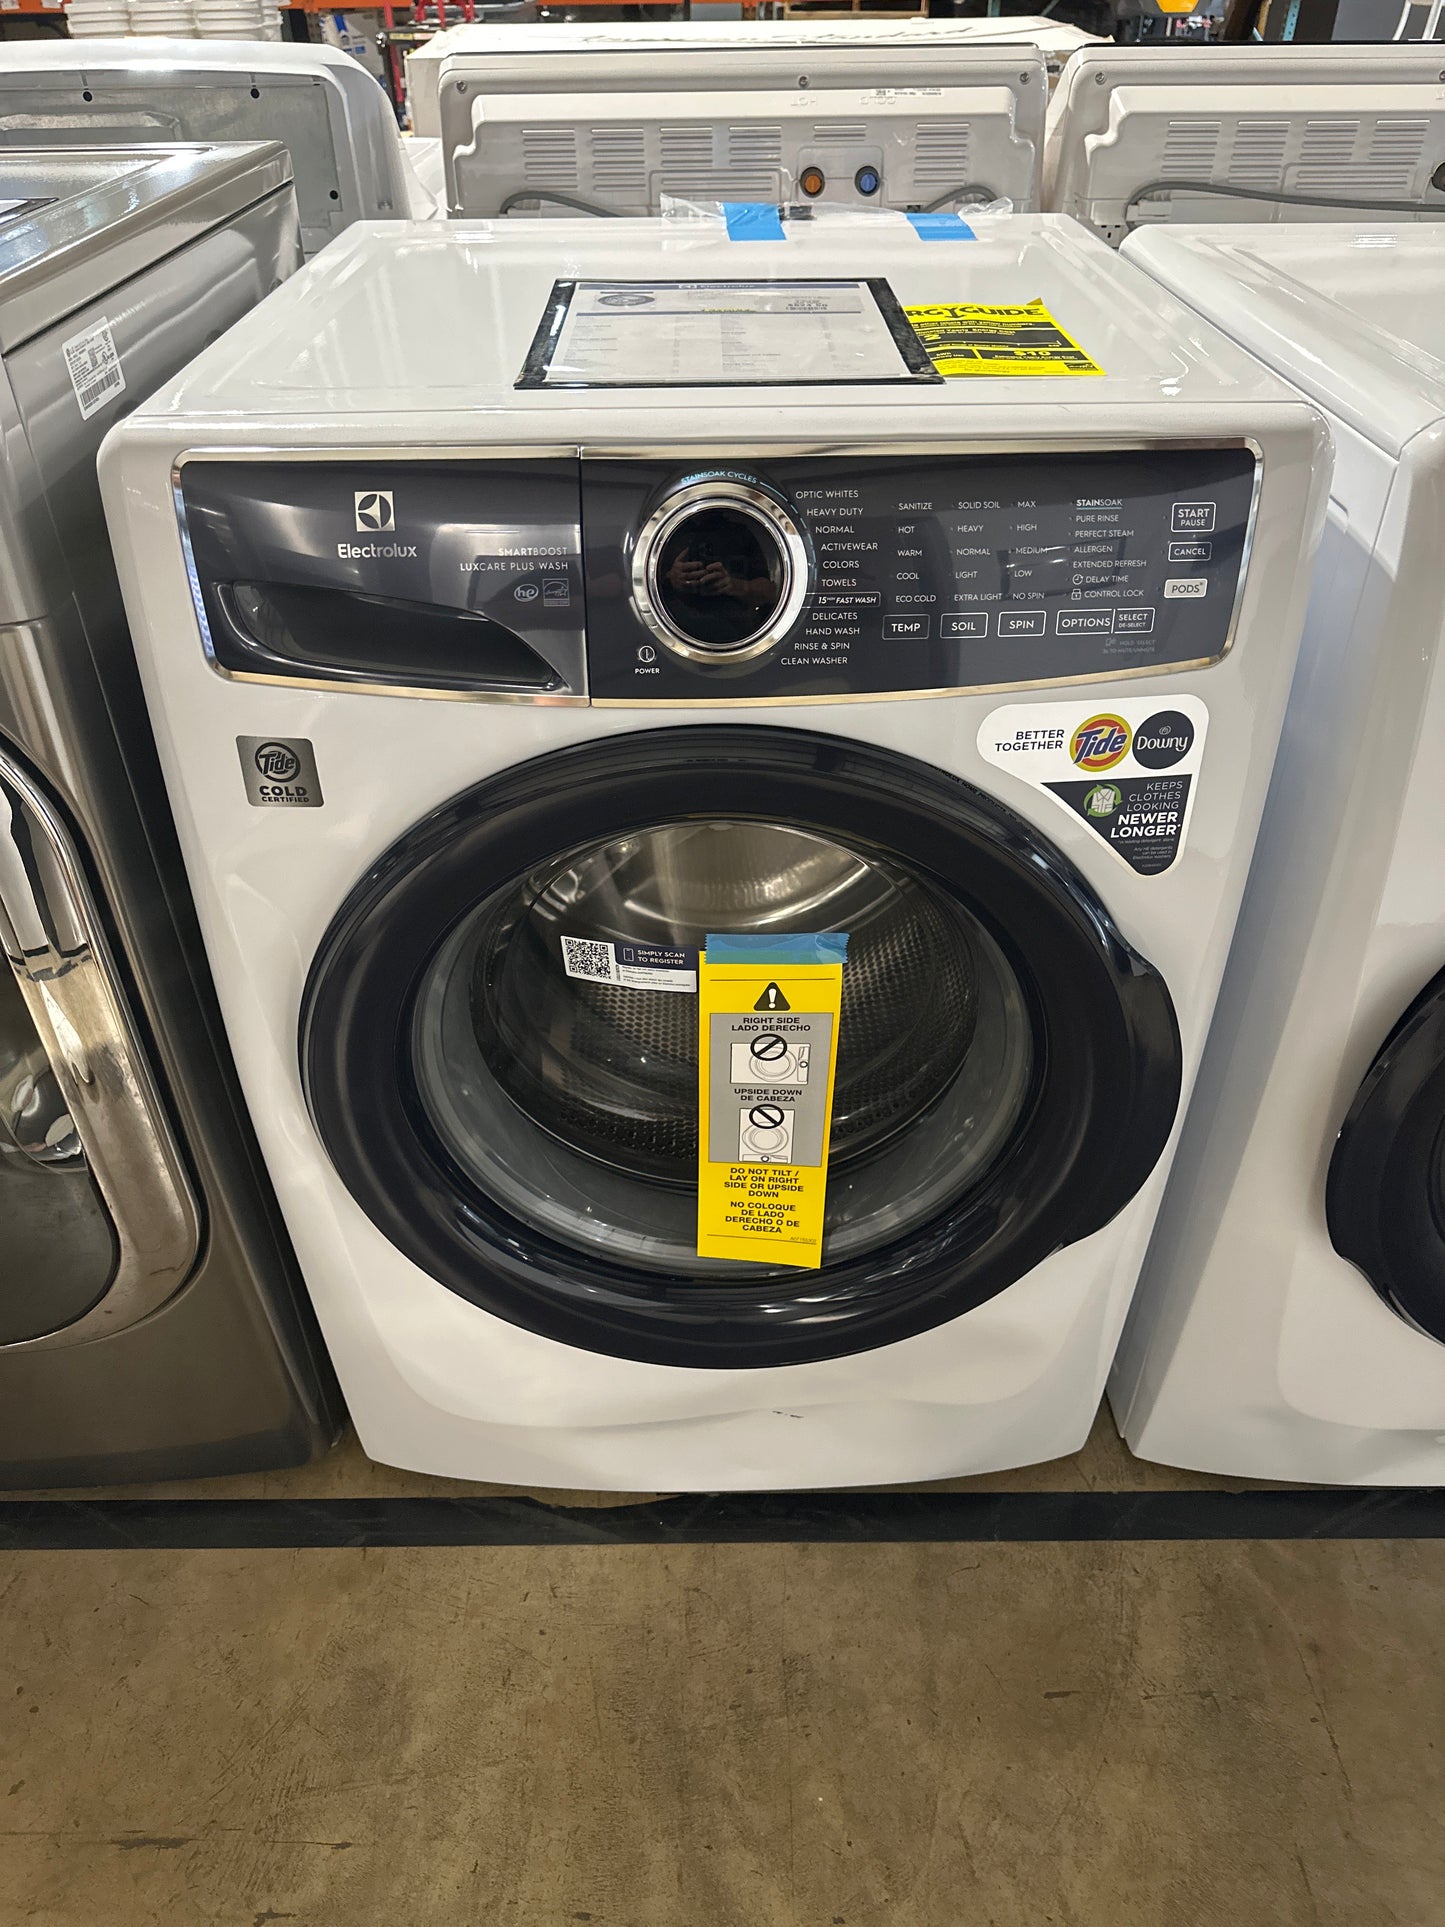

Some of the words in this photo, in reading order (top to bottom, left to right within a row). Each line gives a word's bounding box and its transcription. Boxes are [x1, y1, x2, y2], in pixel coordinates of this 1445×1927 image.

[904, 306, 1044, 318] RGYGUIDE
[681, 471, 725, 484] STAINSOAK
[727, 472, 757, 484] CYCLES
[796, 491, 823, 499] OPTIC
[826, 490, 858, 498] WHITES
[983, 501, 1000, 509] SOIL
[806, 508, 837, 516] HEAVY
[839, 507, 864, 516] DUTY
[1178, 508, 1210, 518] START
[815, 526, 854, 534] NORMAL
[338, 543, 417, 559] Electrolux
[821, 542, 878, 551] ACTIVEWEAR
[498, 547, 567, 557] SMARTBOOST
[460, 562, 506, 572] LUXCARE
[510, 562, 534, 571] PLUS
[538, 562, 569, 570] WASH
[822, 579, 856, 587] TOWELS
[812, 612, 858, 621] DELICATES
[891, 623, 920, 632] TEMP
[951, 622, 976, 631] SOIL
[1009, 620, 1034, 629] SPIN
[1062, 618, 1111, 628] OPTIONS
[805, 627, 832, 636] HAND
[834, 626, 860, 635] WASH
[794, 642, 819, 651] RINSE
[822, 642, 828, 650] &
[830, 642, 850, 650] SPIN
[781, 657, 809, 666] CLEAN
[812, 656, 848, 665] WASHER
[1016, 729, 1065, 740] BETTER
[995, 741, 1063, 752] TOGETHER
[1073, 726, 1128, 764] Tide
[1137, 735, 1189, 752] Downy
[259, 751, 294, 775] Tide
[259, 786, 307, 796] COLD
[1147, 781, 1183, 791] KEEPS
[1129, 792, 1181, 802] CLOTHES
[1127, 802, 1179, 812] LOOKING
[1118, 812, 1178, 825] NEWER
[768, 1184, 804, 1192] UPSIDE
[748, 1202, 796, 1211] COLOQUE
[725, 1216, 773, 1225] DERECHO
[742, 1225, 782, 1233] CABEZA
